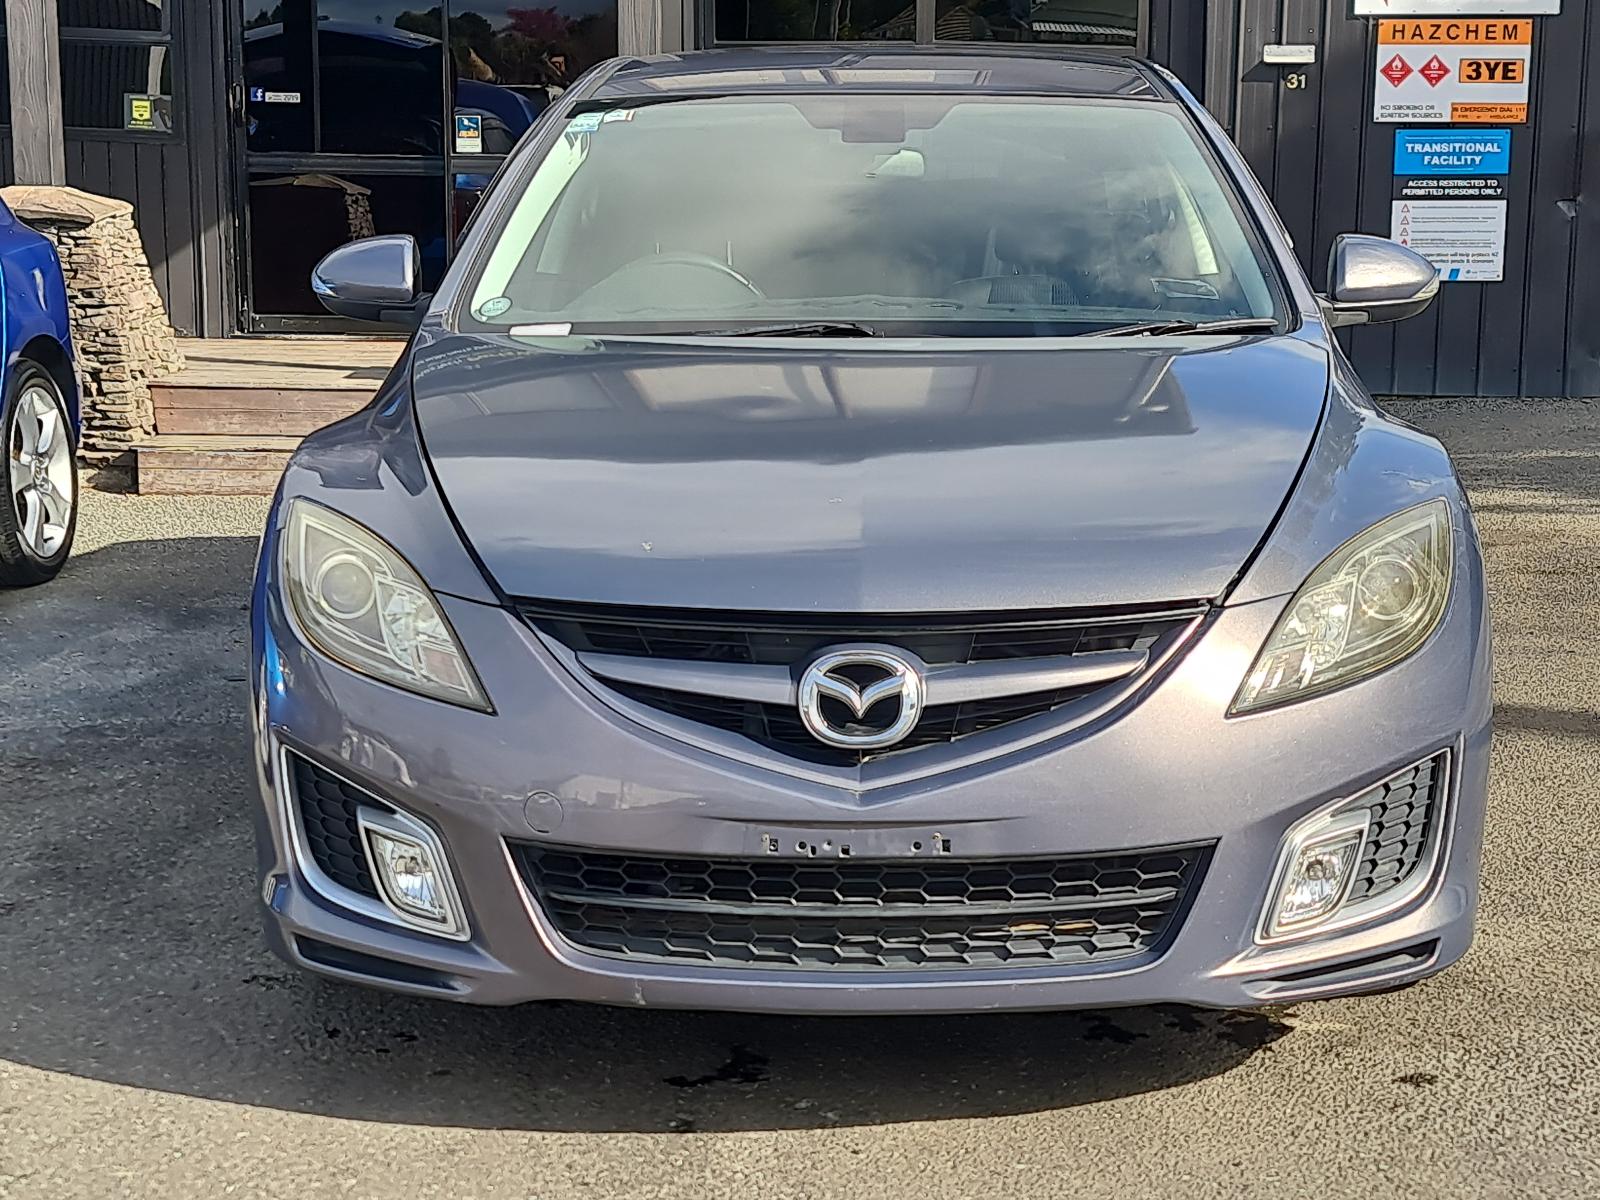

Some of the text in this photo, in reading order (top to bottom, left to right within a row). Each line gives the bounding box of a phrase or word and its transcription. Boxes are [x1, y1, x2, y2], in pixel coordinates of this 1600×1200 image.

[1391, 24, 1518, 40] HAZCHEM
[1466, 61, 1517, 80] 3YE
[1286, 73, 1306, 89] 31
[1405, 143, 1502, 153] TRANSITIONAL
[1423, 155, 1482, 165] FACILITY
[1402, 188, 1444, 196] PERMITTED
[1445, 188, 1480, 196] PERSONS
